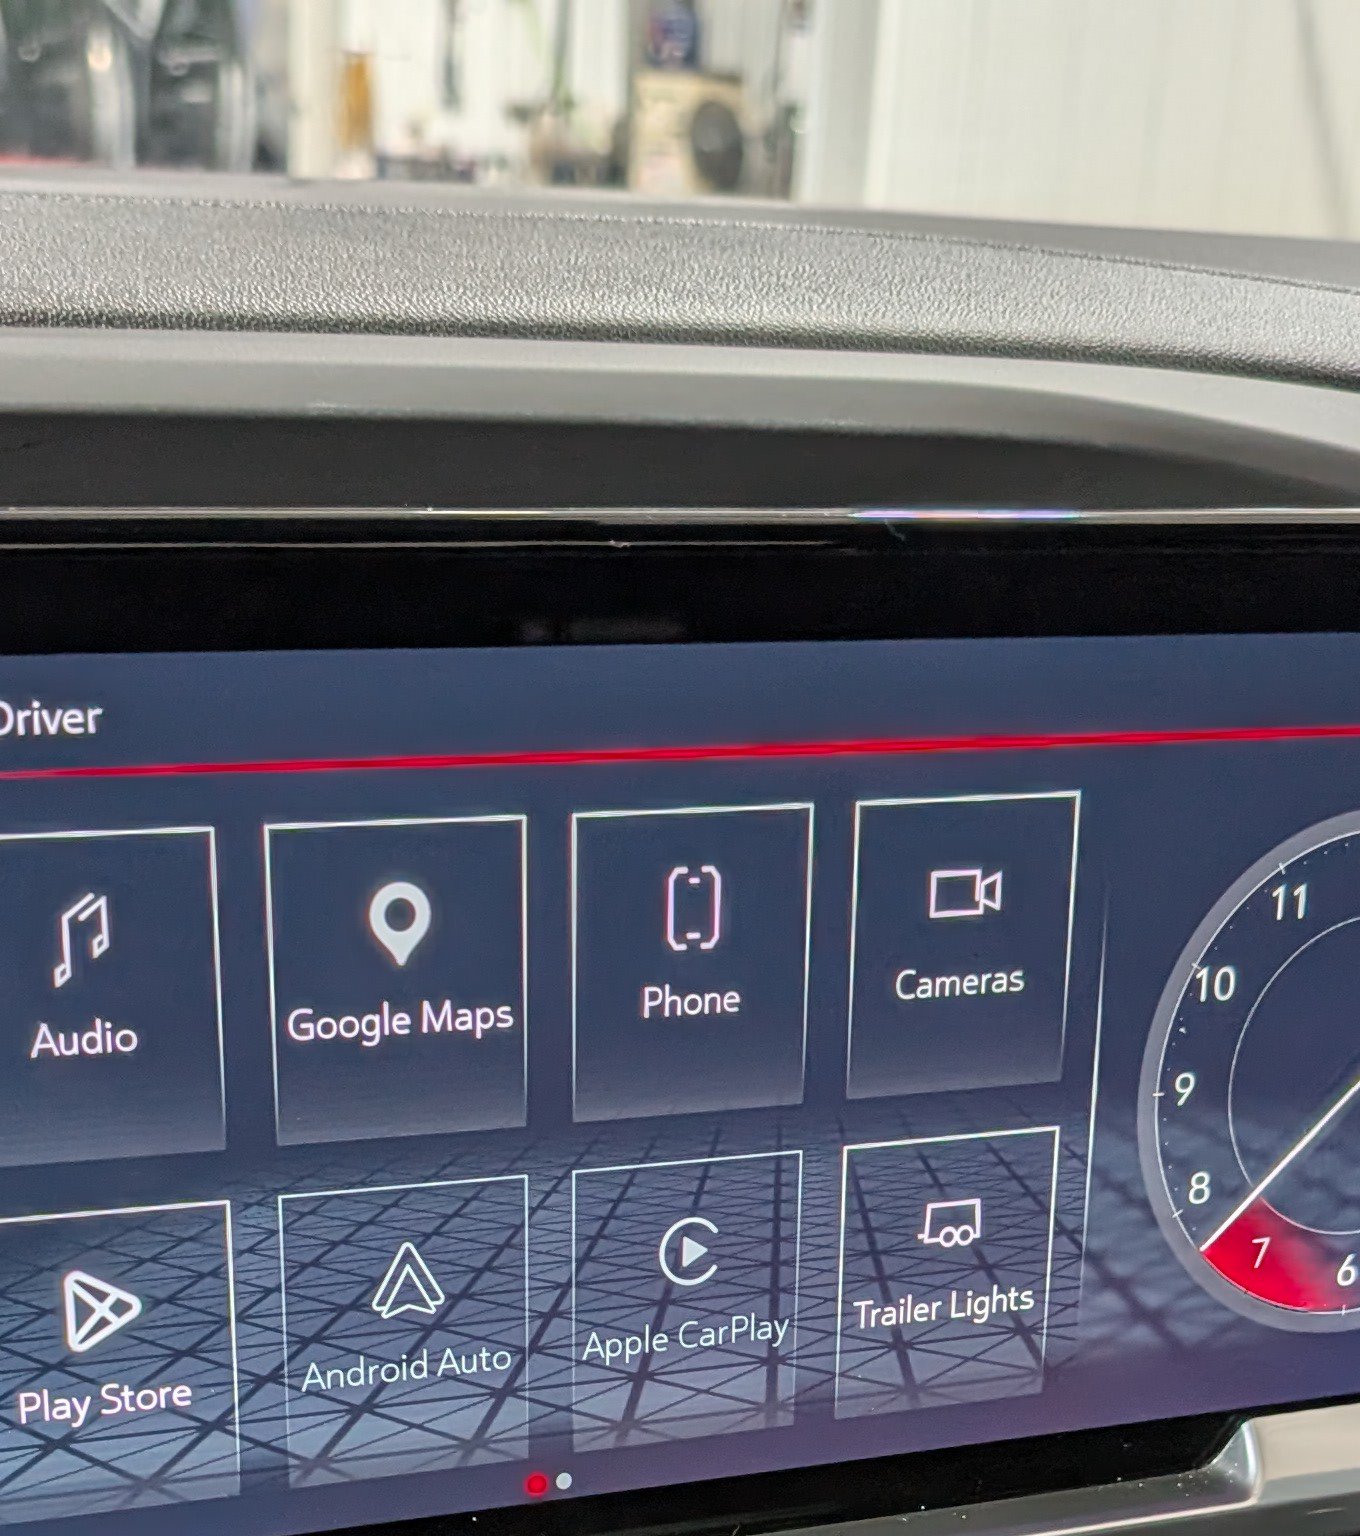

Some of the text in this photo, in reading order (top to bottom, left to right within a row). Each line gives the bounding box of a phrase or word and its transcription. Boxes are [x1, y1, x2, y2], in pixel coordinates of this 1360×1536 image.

[1272, 884, 1307, 921] 11
[643, 983, 741, 1019] Phone
[895, 969, 1025, 1000] Cameras
[1196, 966, 1236, 1003] 10
[30, 1017, 138, 1059] Audio
[287, 999, 514, 1047] Google Maps
[1174, 1072, 1195, 1106] 9
[1188, 1171, 1210, 1205] 8
[1251, 1236, 1271, 1269] 7
[1336, 1253, 1357, 1287] 6
[852, 1284, 1035, 1329] Trailer Lights
[581, 1312, 790, 1366] Apple CarPlay
[301, 1346, 512, 1393] Android Auto
[19, 1383, 193, 1428] Play Store
